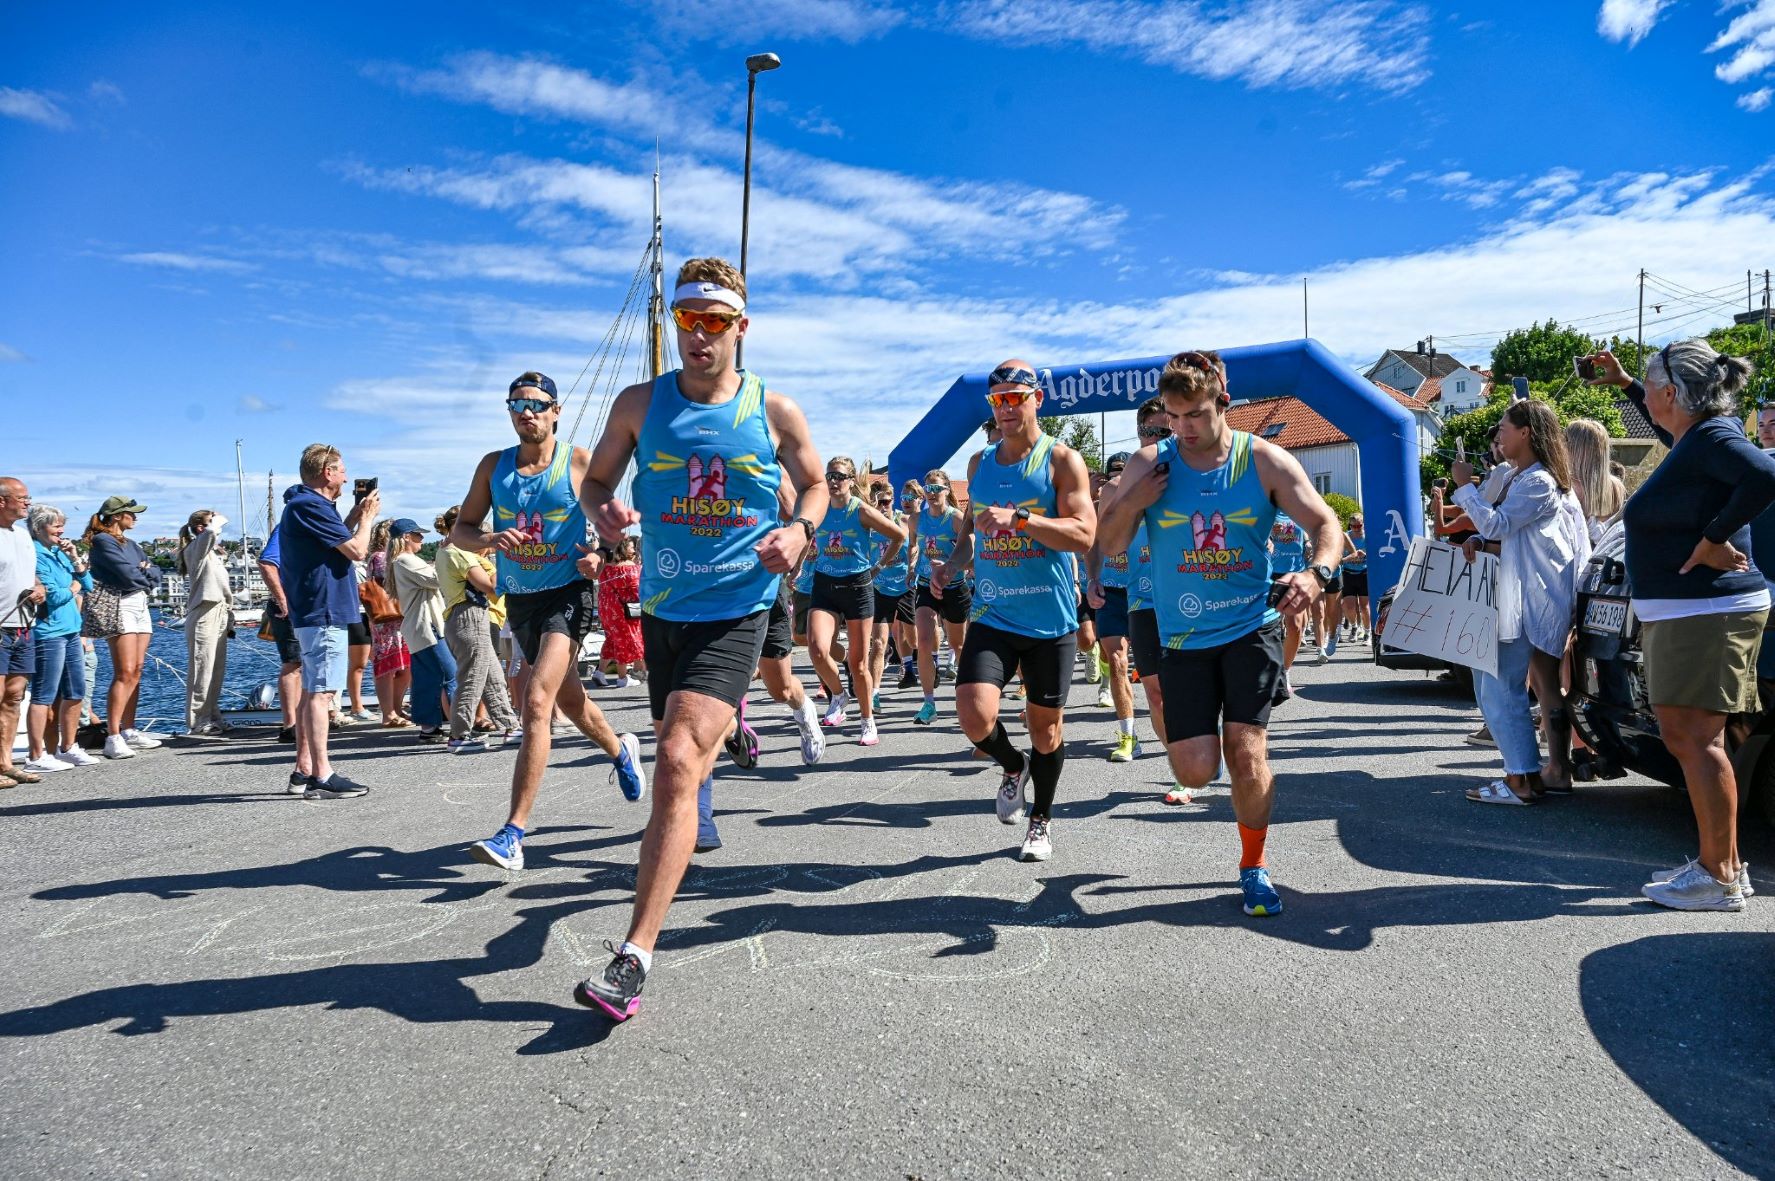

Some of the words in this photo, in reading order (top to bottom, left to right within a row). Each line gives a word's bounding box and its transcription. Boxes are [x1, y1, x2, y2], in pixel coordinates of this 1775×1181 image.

[1038, 367, 1162, 409] Agderpo
[671, 497, 745, 515] HISØY
[661, 512, 758, 527] MARATHON
[691, 527, 722, 537] 2022
[983, 536, 1034, 551] HISØY
[981, 550, 1046, 560] MARATHON
[1183, 548, 1242, 565] HISØY
[684, 559, 755, 576] Sparekassa
[1177, 561, 1253, 573] MARATHON
